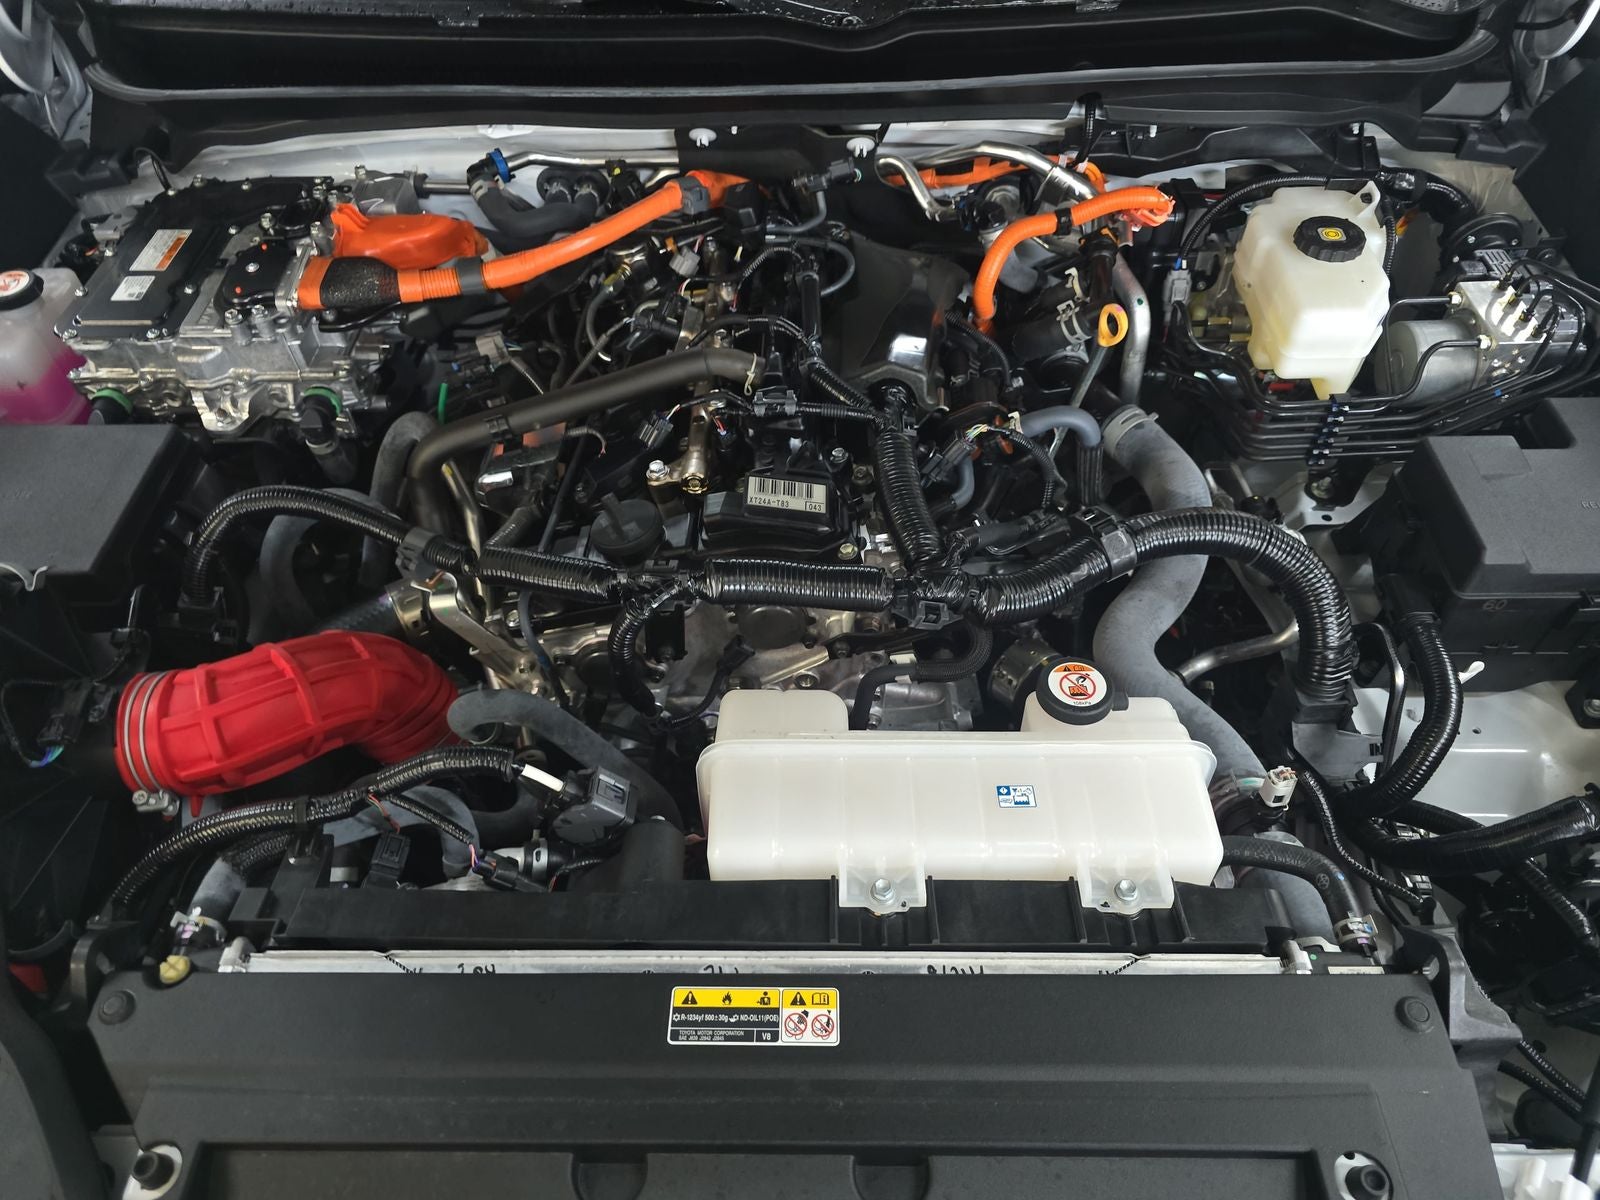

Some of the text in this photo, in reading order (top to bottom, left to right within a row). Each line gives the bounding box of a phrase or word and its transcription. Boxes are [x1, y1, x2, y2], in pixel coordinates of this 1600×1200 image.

[749, 497, 789, 508] XT24A-T83
[681, 1013, 704, 1022] R-1234yf
[740, 1014, 778, 1023] ND-OIL11(POE)
